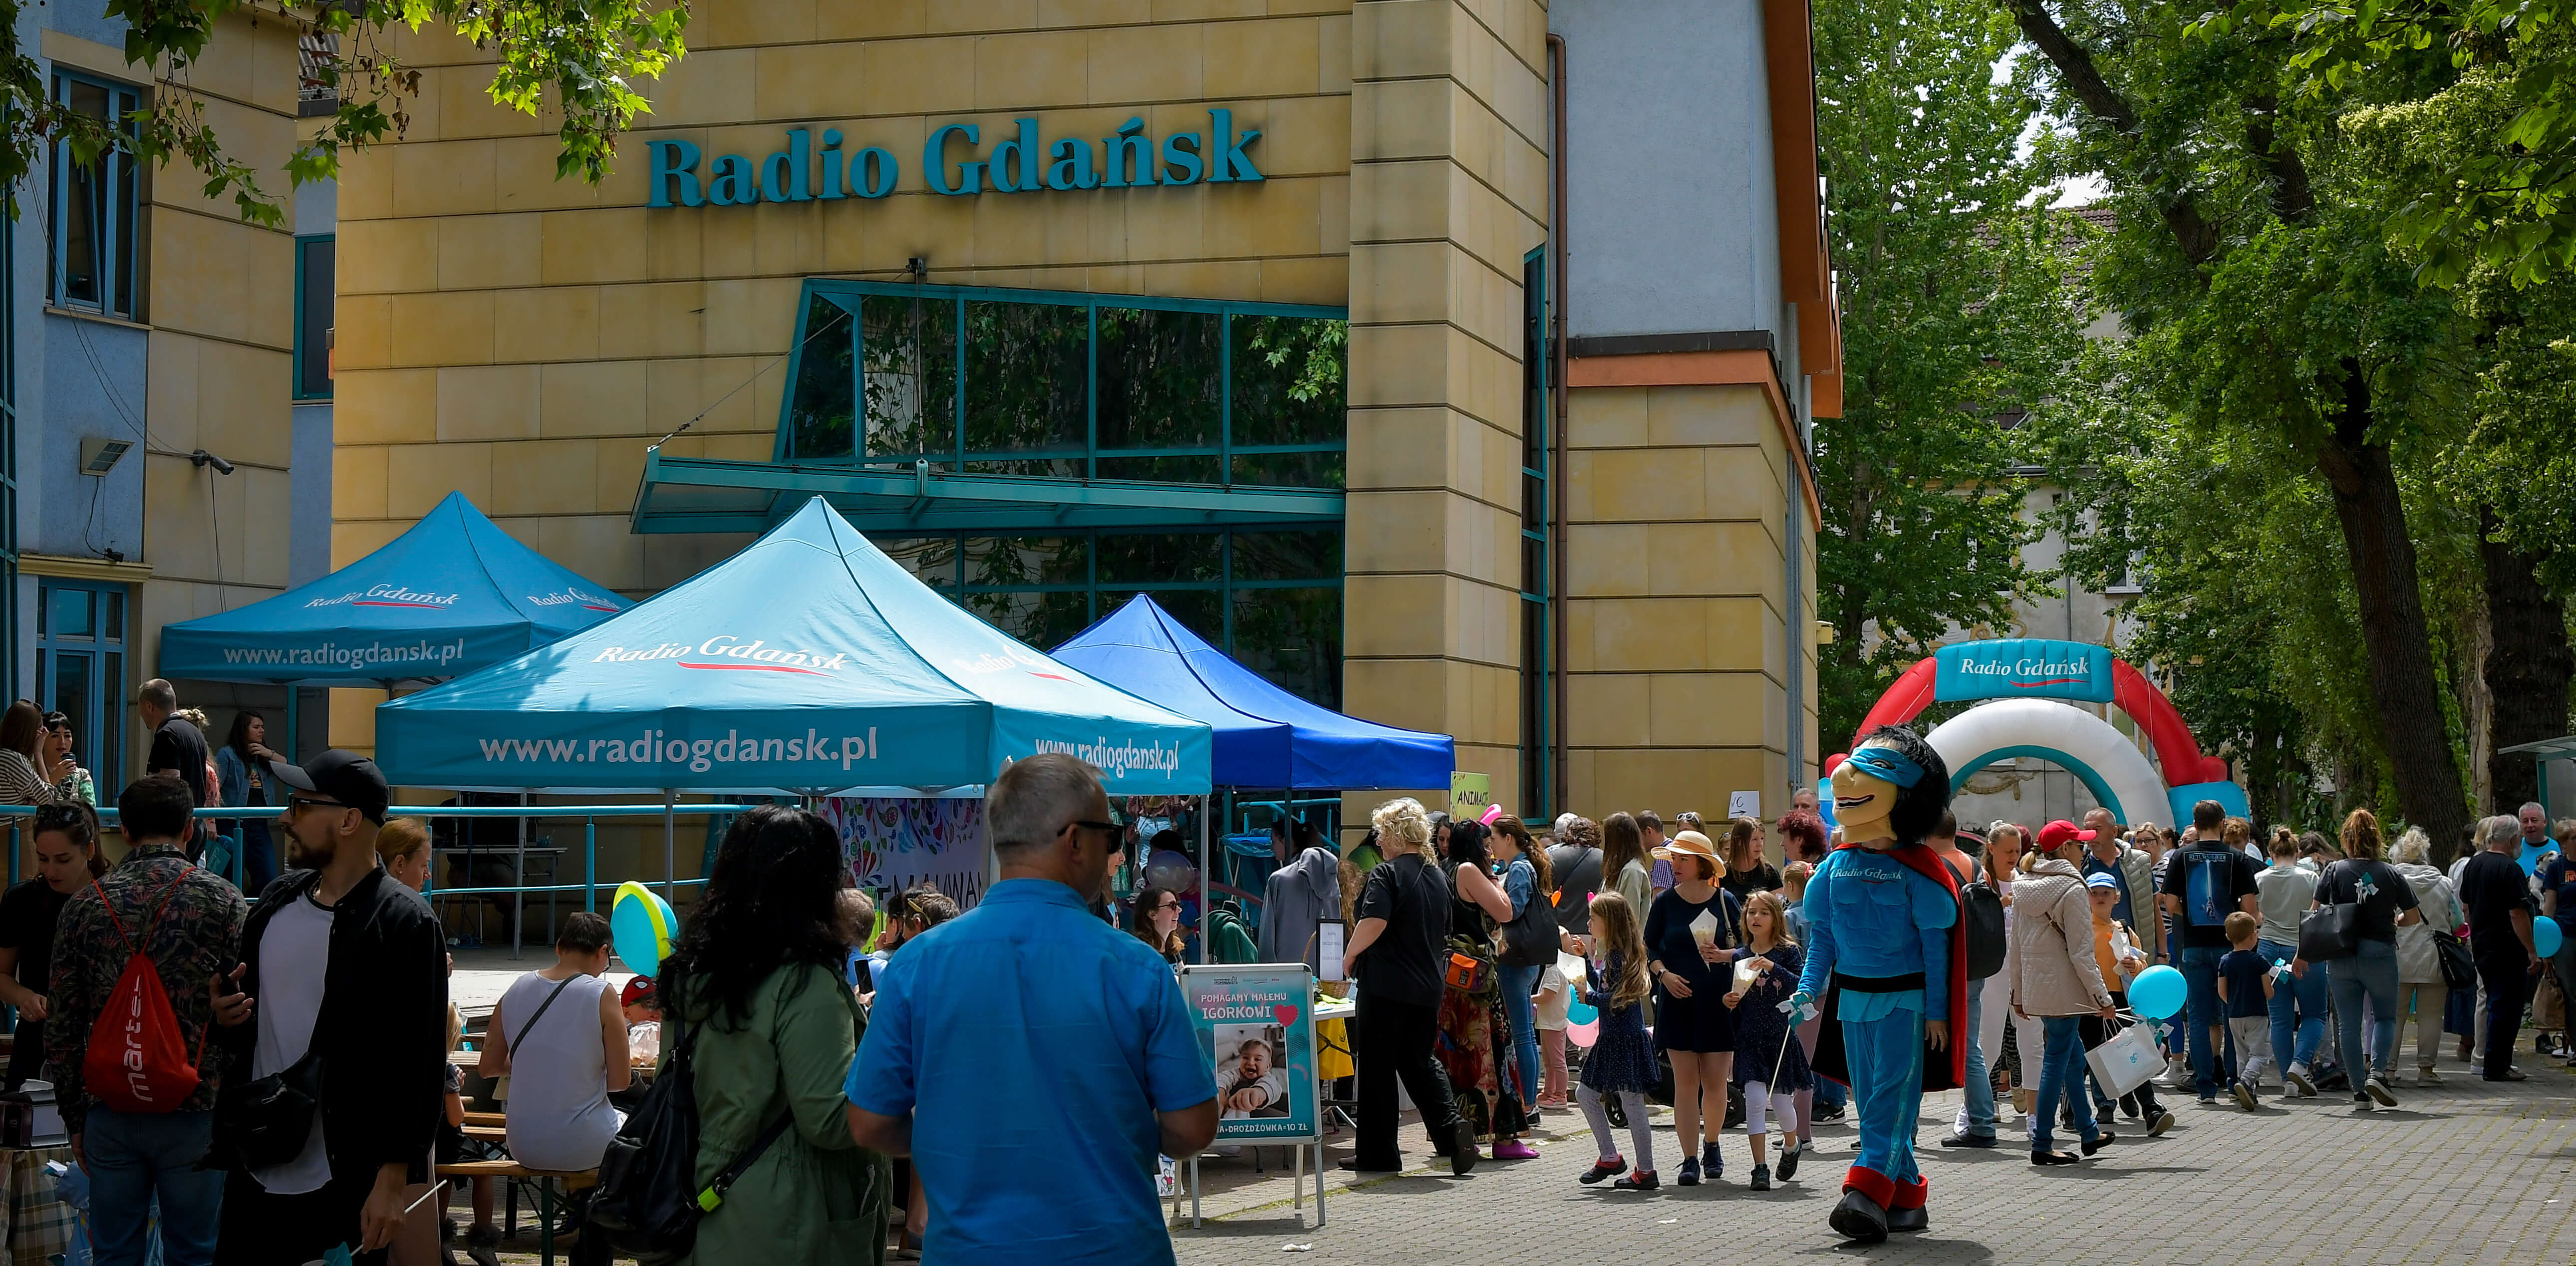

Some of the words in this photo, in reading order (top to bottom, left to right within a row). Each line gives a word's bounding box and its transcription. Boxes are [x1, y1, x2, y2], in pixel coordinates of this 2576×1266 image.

[644, 127, 898, 209] Radio
[923, 108, 1267, 197] Gdańsk
[303, 592, 363, 608] Radio
[366, 584, 460, 605] Gdańsk
[527, 592, 573, 606] Radio
[224, 638, 464, 669] www.radiogdansk.pl
[590, 641, 692, 663] Radio
[699, 634, 855, 671] Gdańsk
[1960, 658, 2011, 675] Radio
[2015, 656, 2089, 676] Gdańsk
[479, 726, 878, 772] www.radiogdansk.pl
[1035, 736, 1179, 780] wwwradiogdansk.pl
[1835, 868, 1862, 877] Radio
[1201, 993, 1248, 1002] POMAGAMY
[1252, 992, 1287, 1001] MAŁEMU
[1202, 1006, 1271, 1019] IGORKOWI
[1298, 1123, 1308, 1131] ZŁ
